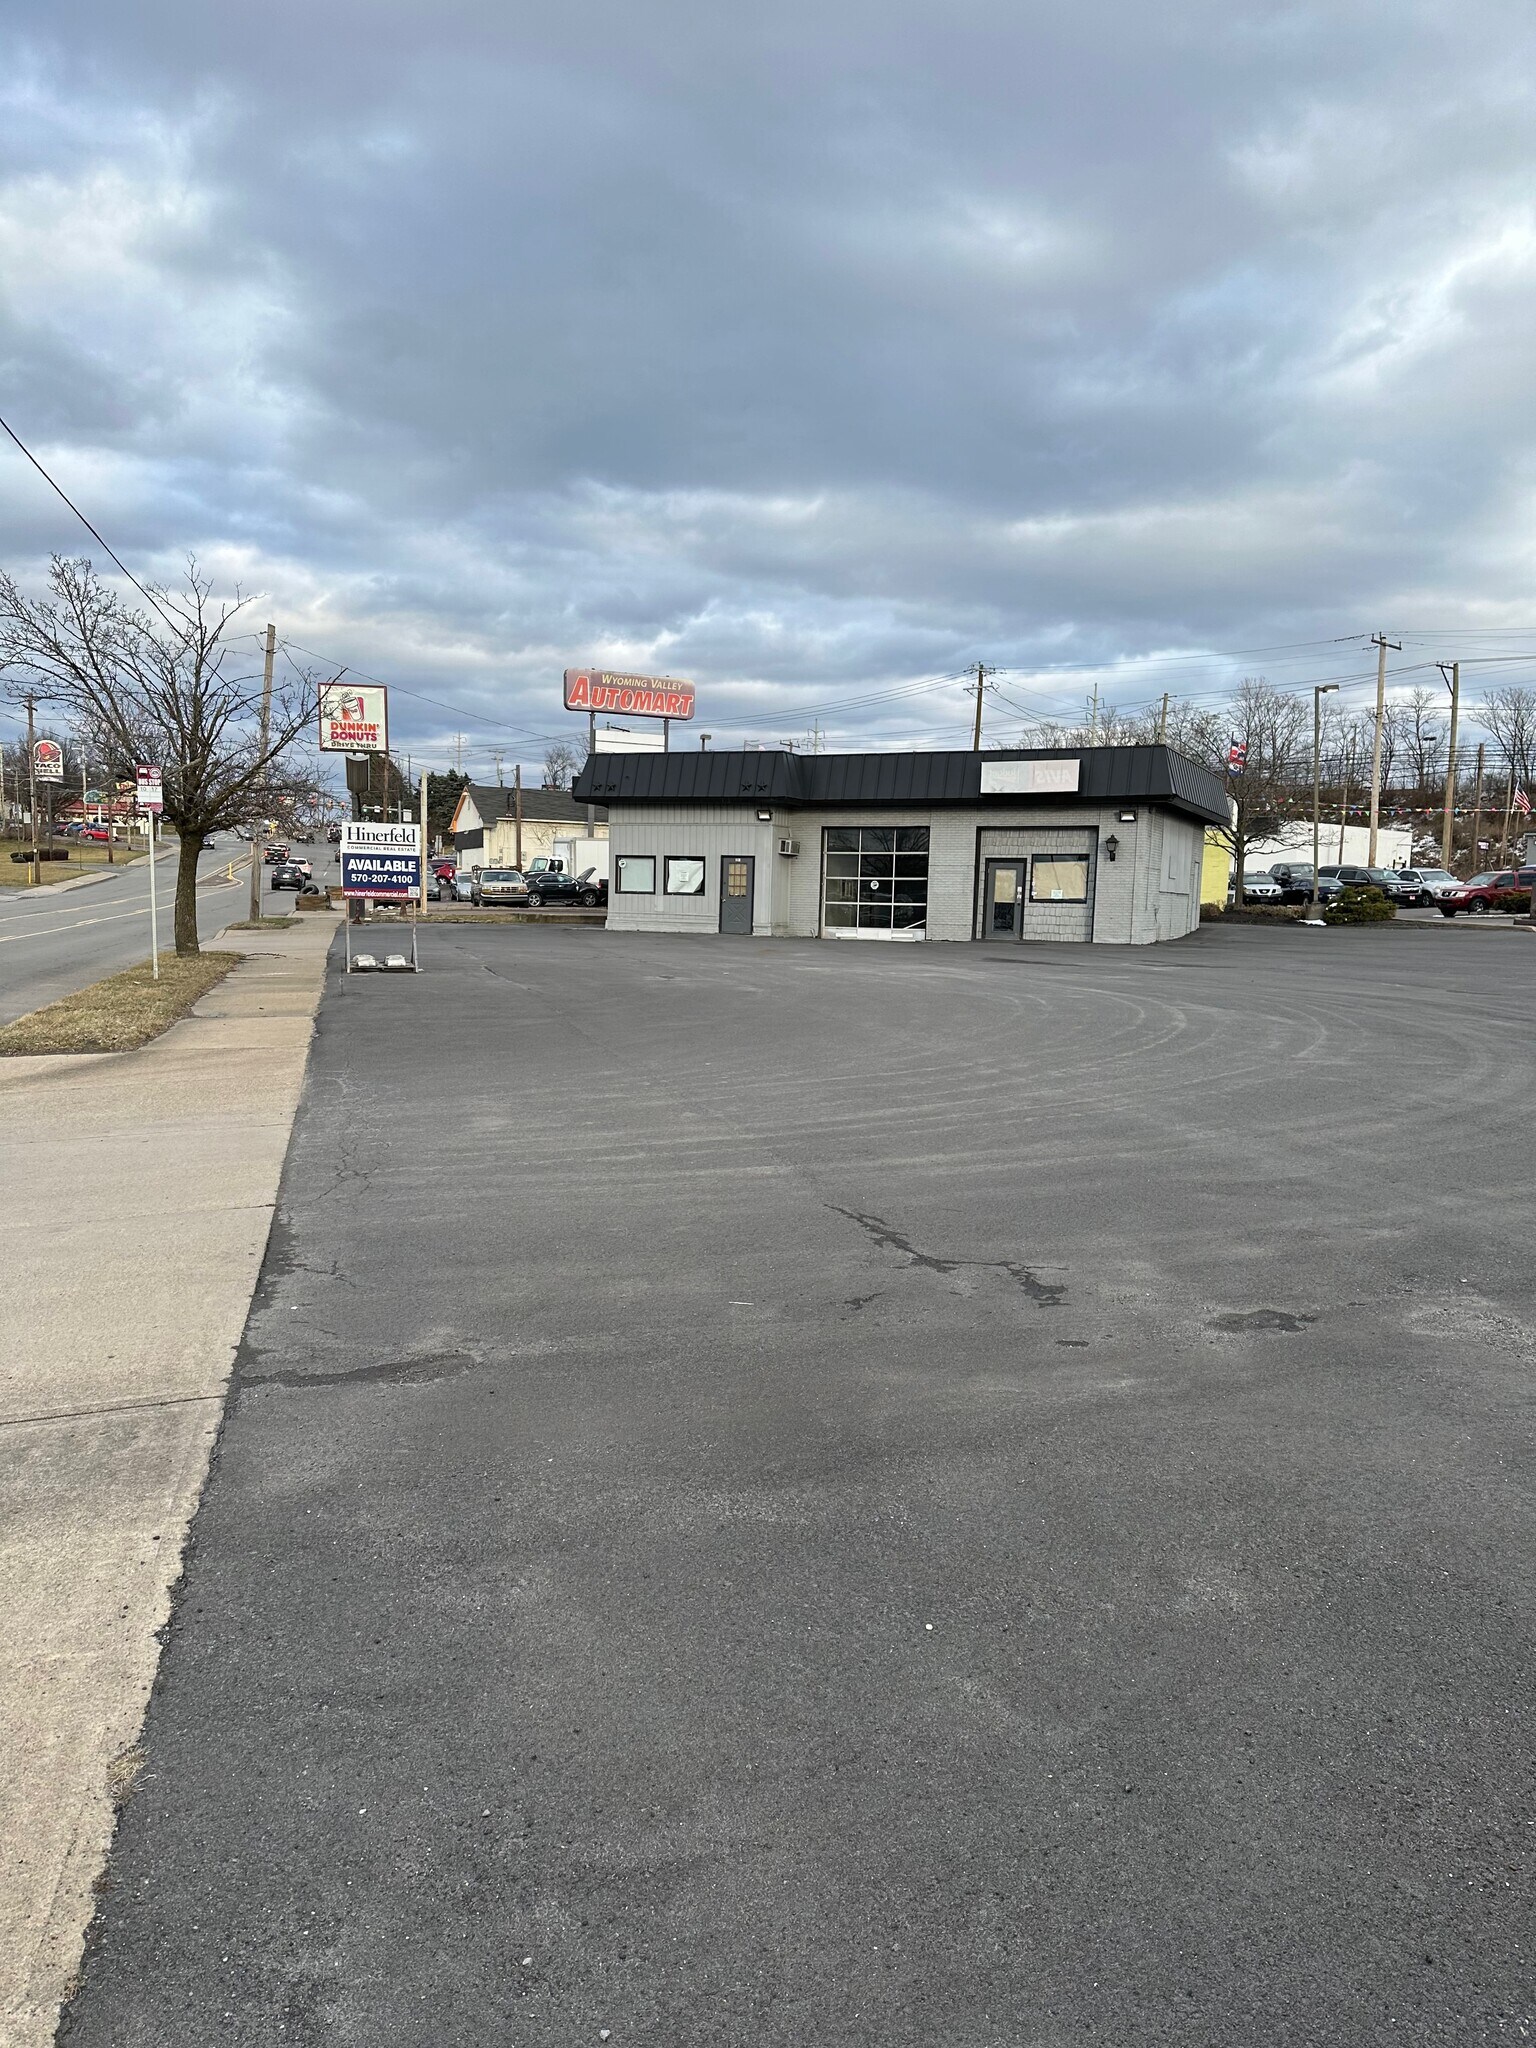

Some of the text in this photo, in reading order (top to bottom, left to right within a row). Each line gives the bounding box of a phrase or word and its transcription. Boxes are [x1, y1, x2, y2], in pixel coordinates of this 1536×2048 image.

[330, 731, 378, 741] DONUTS
[138, 778, 148, 786] BUS
[148, 778, 161, 786] STOP
[347, 826, 416, 843] Hinerfeld
[347, 858, 417, 872] AVAILABLE
[351, 873, 413, 884] 570-207-4100
